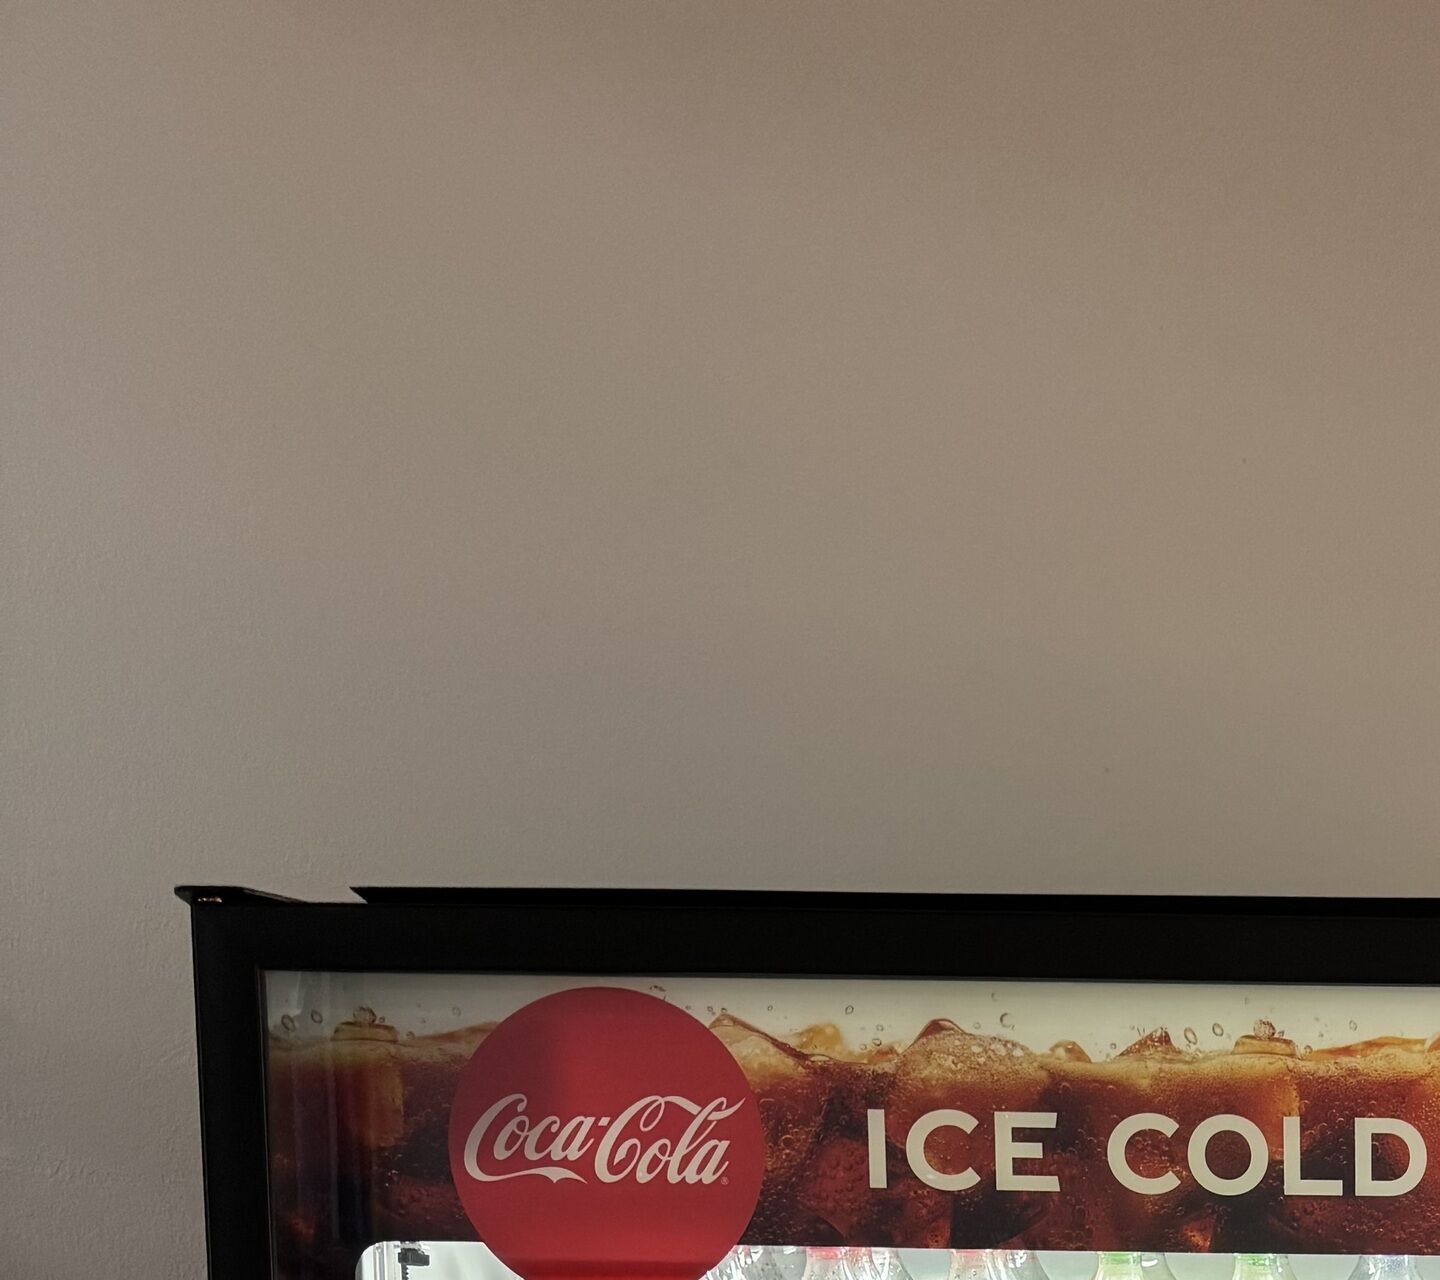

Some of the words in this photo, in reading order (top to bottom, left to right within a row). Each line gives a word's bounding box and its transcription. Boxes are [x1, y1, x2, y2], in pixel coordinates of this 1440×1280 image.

[464, 1093, 746, 1184] Coca-Cola
[867, 1108, 1061, 1192] ICE
[1107, 1112, 1428, 1197] COLD
